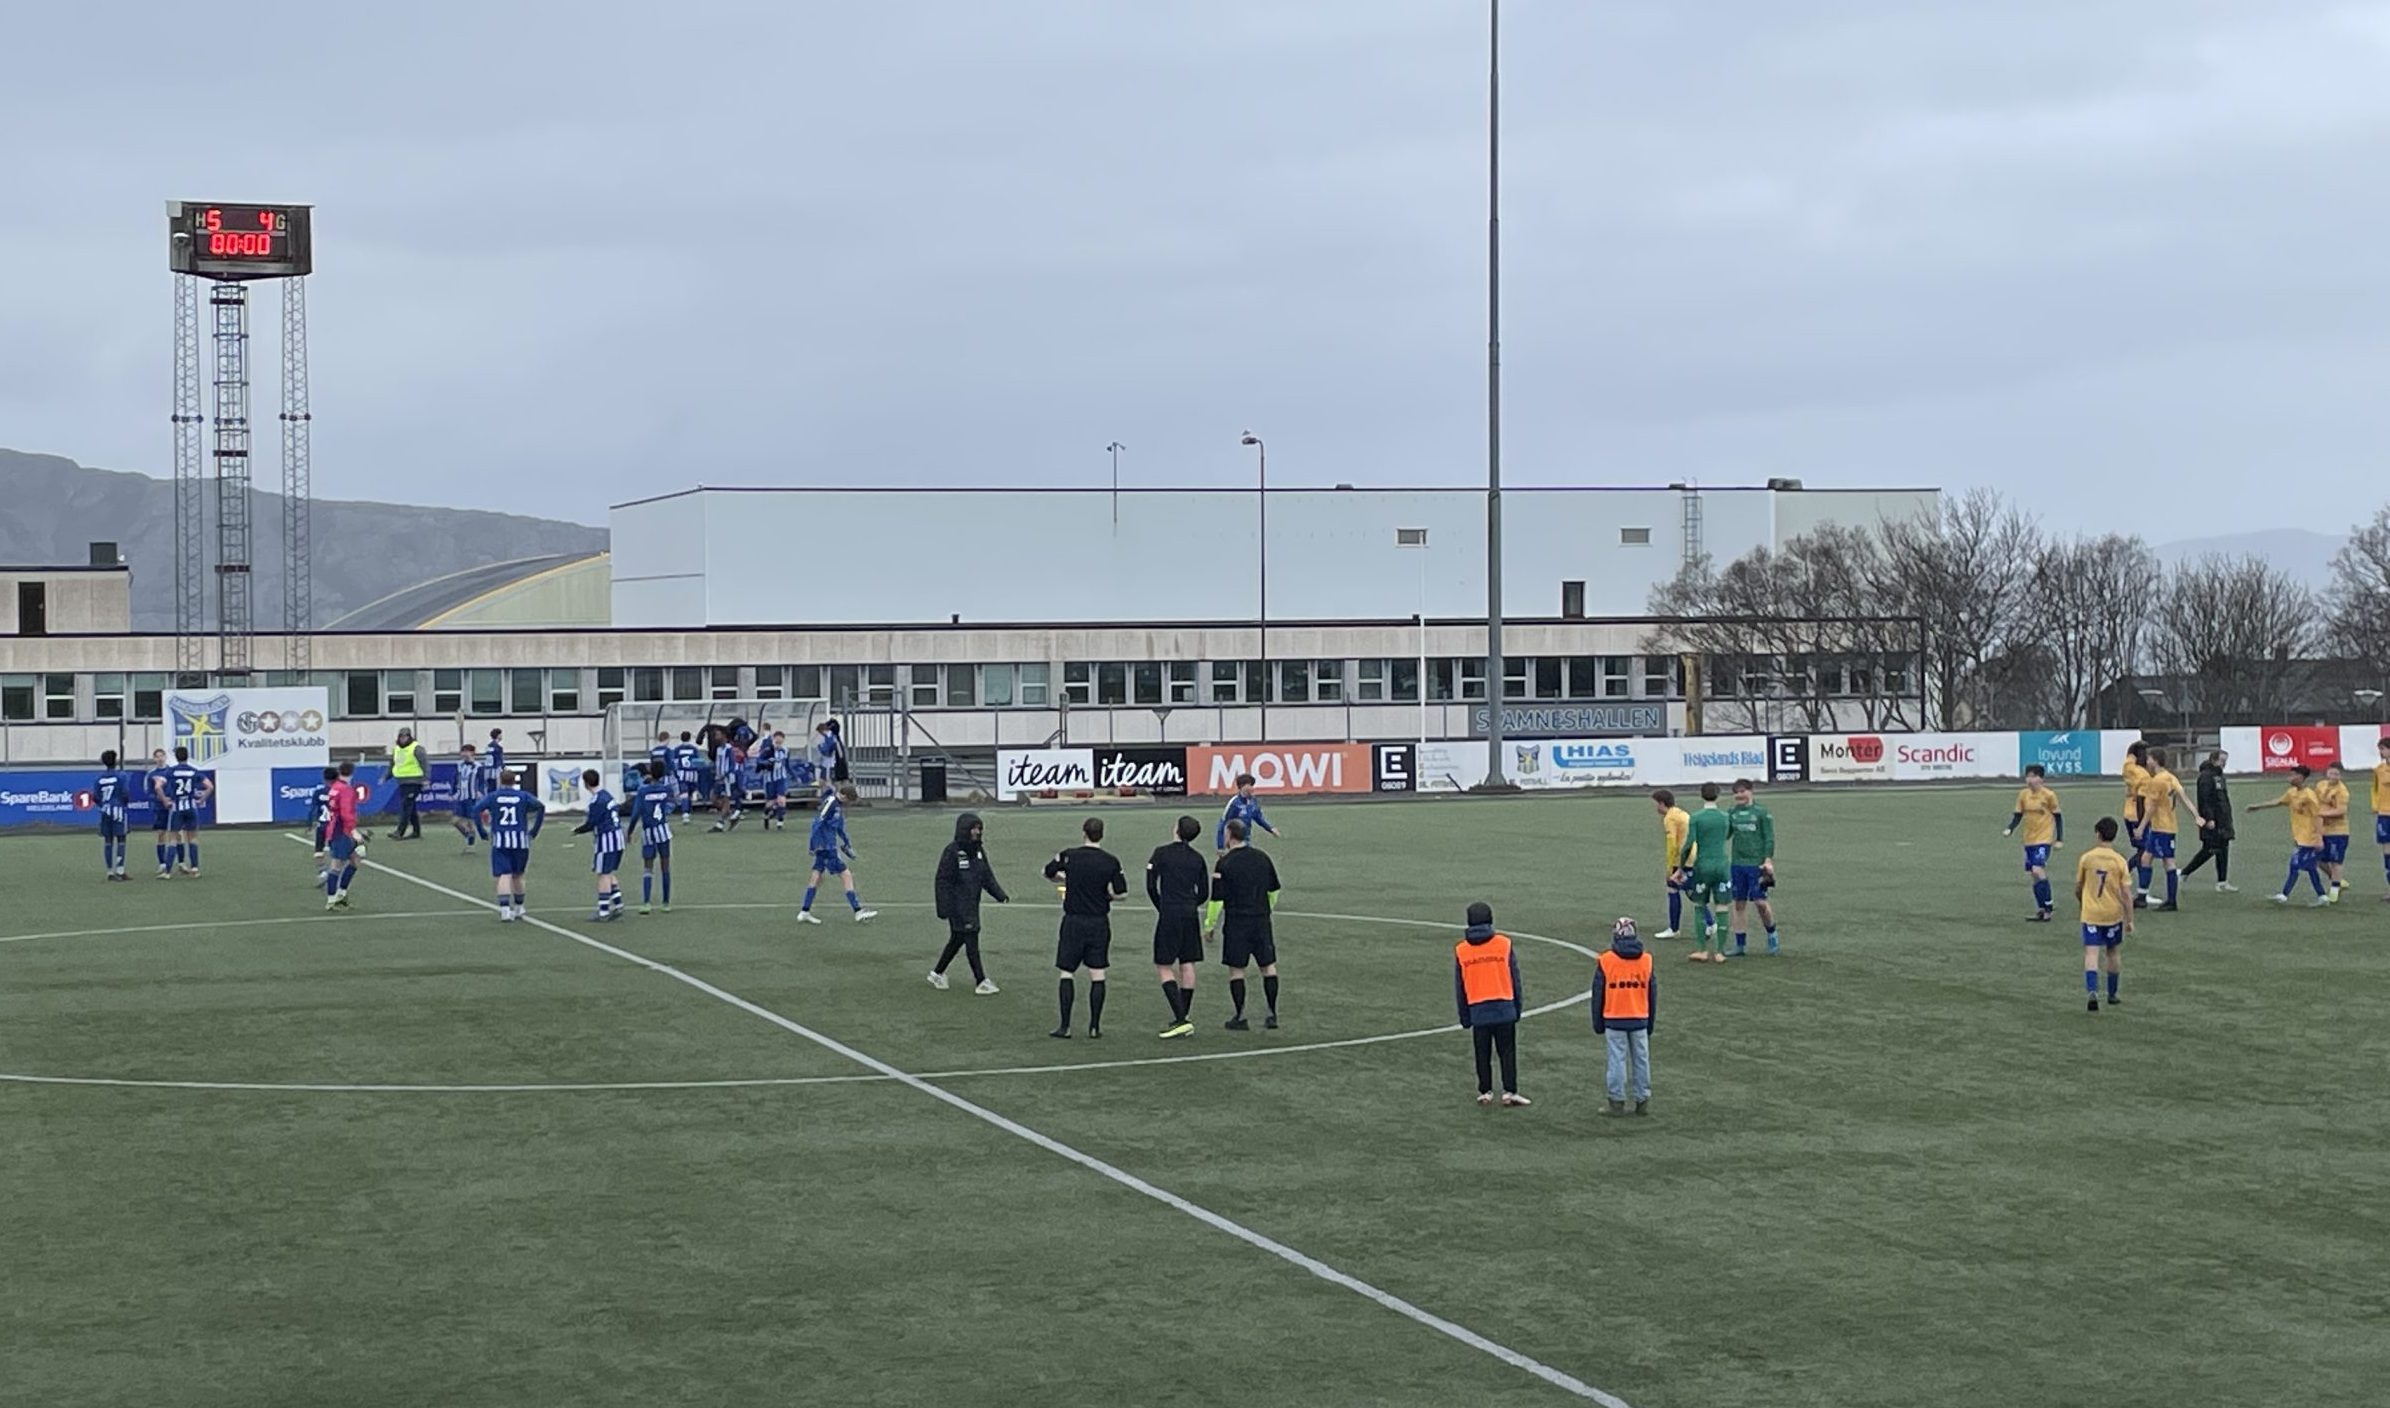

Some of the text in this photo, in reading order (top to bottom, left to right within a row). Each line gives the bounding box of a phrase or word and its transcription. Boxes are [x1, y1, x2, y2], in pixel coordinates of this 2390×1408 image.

[195, 209, 286, 231] H 5 4 G
[211, 233, 270, 254] 00:00
[1476, 707, 1660, 731] SAMNESHALLEN
[238, 736, 325, 748] Kvalitetsklubb
[1568, 744, 1630, 757] HIAS
[1898, 744, 1974, 763] Scandic
[1008, 754, 1089, 786] iteam
[1101, 752, 1183, 787] iteam
[1209, 752, 1343, 788] MOWI
[176, 779, 192, 794] 24
[356, 787, 365, 800] 1
[0, 791, 89, 807] SpareBank 1
[500, 806, 518, 825] 21
[653, 802, 662, 821] 4
[2096, 870, 2107, 898] 7
